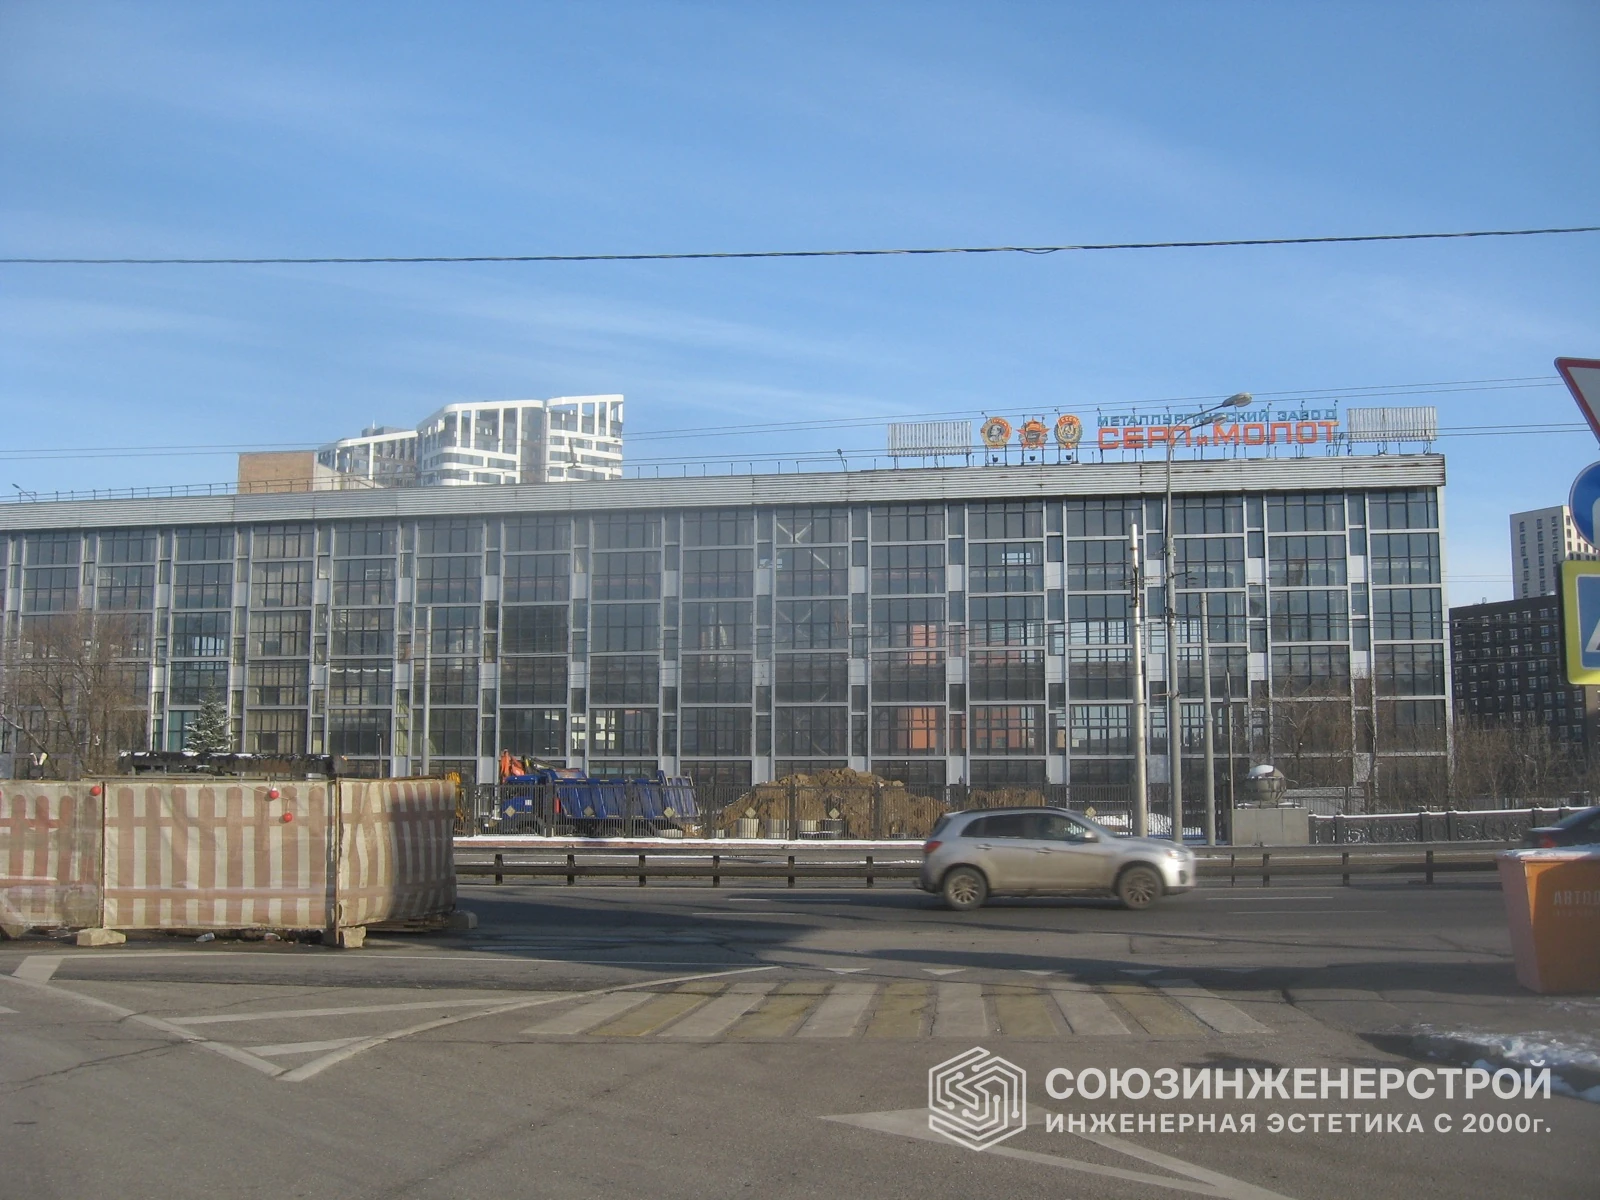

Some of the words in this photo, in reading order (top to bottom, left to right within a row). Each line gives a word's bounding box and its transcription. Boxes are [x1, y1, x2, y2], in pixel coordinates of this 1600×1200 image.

[1097, 409, 1269, 426] МЕТАЛЛУРГИСКИЙ
[1277, 409, 1337, 422] ЗАВОД
[1098, 426, 1191, 449] СЕРП
[1212, 421, 1340, 446] МОЛОТ
